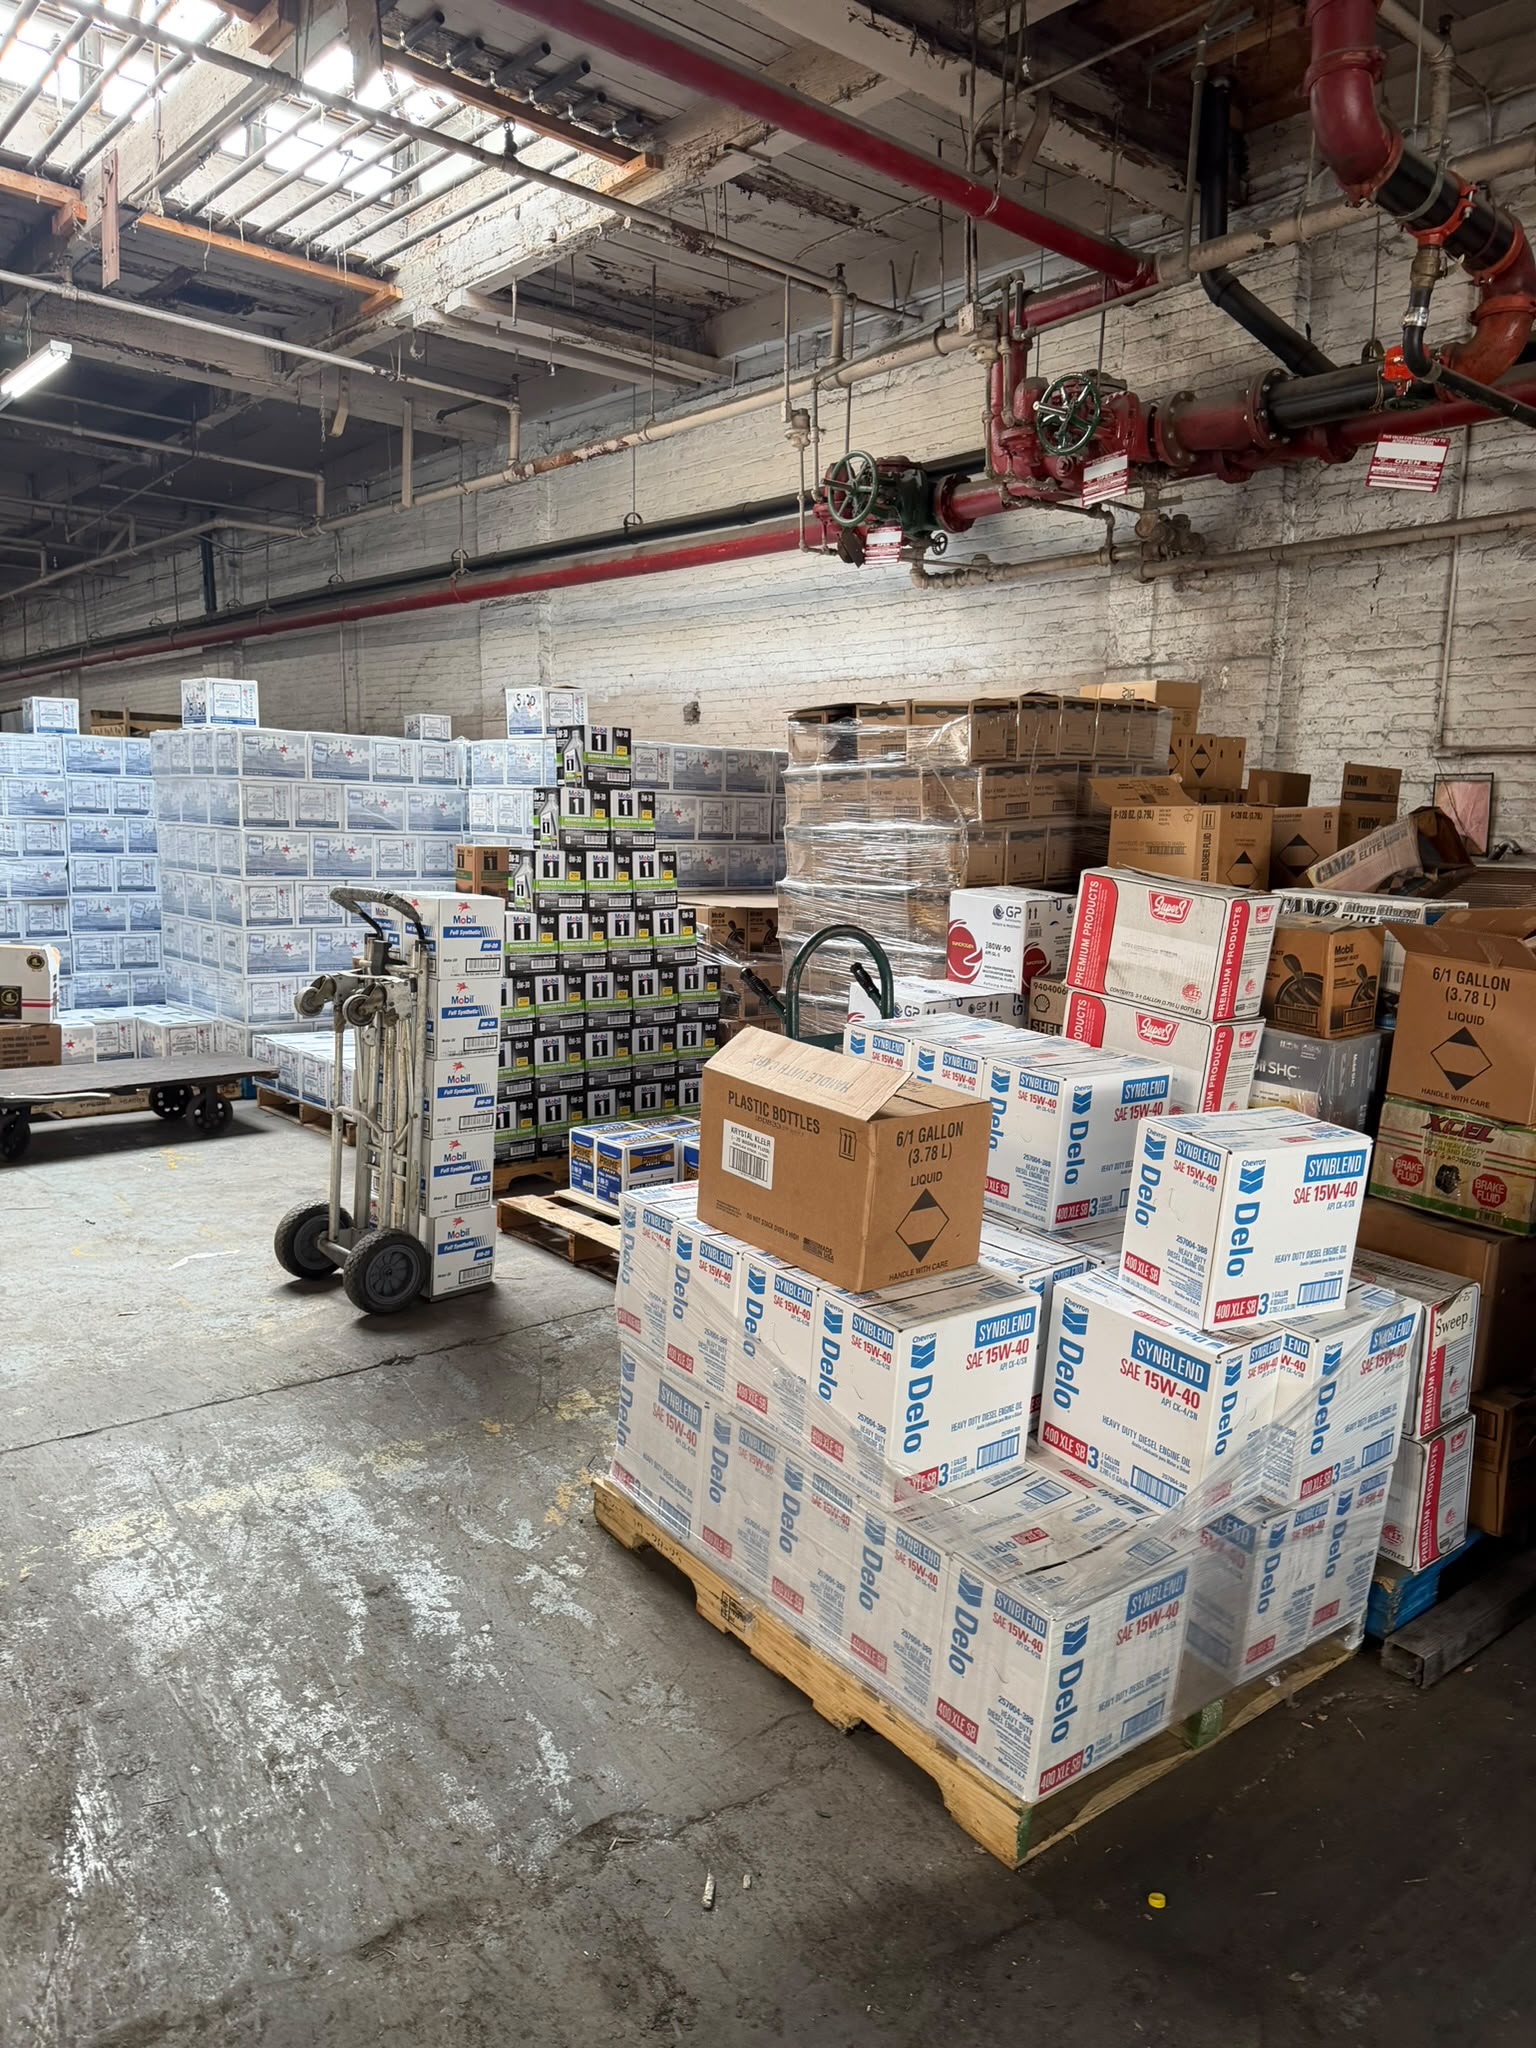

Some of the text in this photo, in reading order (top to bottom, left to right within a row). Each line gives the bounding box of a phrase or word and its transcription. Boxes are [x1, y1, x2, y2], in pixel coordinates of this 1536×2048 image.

[1359, 842, 1383, 861] ELITE
[453, 916, 476, 924] Mobil
[1006, 906, 1022, 918] GP
[1074, 880, 1100, 985] PREMIUM PRODUCTS
[1218, 906, 1242, 1017] PREMIUM PRODUCTS
[1335, 944, 1354, 955] Mobil
[1433, 967, 1510, 992] 6/1 GALLON
[451, 995, 474, 1004] Mobil
[1446, 986, 1496, 1010] (3.78 L)
[1074, 1000, 1087, 1040] ODUCTS
[1448, 1011, 1485, 1026] LIQUID
[1209, 1031, 1226, 1089] PRODUCTS
[1268, 1062, 1297, 1078] SHC
[447, 1074, 470, 1084] Mobil
[1020, 1075, 1059, 1094] SYNBLEND
[1125, 1080, 1166, 1099] SYNBLEND
[1029, 1093, 1056, 1108] 15W-40
[1421, 1087, 1490, 1109] HANDLE WITH CARE
[729, 1090, 769, 1117] PLASTIC
[772, 1104, 821, 1134] BOTTLES
[1130, 1102, 1163, 1120] 15W-40
[731, 1127, 753, 1141] KRYSTAL
[896, 1122, 963, 1148] 6/1 GALLON
[444, 1152, 466, 1162] Mobil
[908, 1143, 952, 1168] (3.78 L)
[1065, 1120, 1089, 1184] Delo
[1176, 1141, 1220, 1168] SYNBLEND
[1186, 1167, 1217, 1186] 15W-40
[1309, 1155, 1361, 1177] SYNBLEND
[1396, 1160, 1422, 1173] BRAKE
[1397, 1169, 1419, 1183] FLUID
[910, 1171, 942, 1187] LIQUID
[1475, 1180, 1504, 1194] BRAKE
[1135, 1164, 1161, 1226] Delo
[1293, 1181, 1358, 1204] SAE 15W-40
[1477, 1190, 1501, 1203] FLUID
[447, 1229, 470, 1239] Mobil
[1226, 1202, 1260, 1277] Delo
[889, 1259, 949, 1281] HANDLE WITH CARE
[775, 1277, 812, 1305] SYNBLEND
[774, 1295, 811, 1321] SAE 15W-40
[1064, 1297, 1089, 1313] Chevron
[1215, 1293, 1269, 1318] 400 XLE SB 3
[744, 1298, 763, 1359] Delo
[854, 1316, 893, 1346] SYNBLEND
[912, 1333, 937, 1343] Chevron
[979, 1313, 1032, 1342] SYNBLEND
[1435, 1313, 1469, 1338] Sweep
[851, 1335, 892, 1364] SAE 15W-40
[965, 1338, 1029, 1370] SAE 15W-40
[1136, 1338, 1205, 1384] SYNBLEND
[818, 1336, 840, 1402] Delo
[1053, 1337, 1085, 1411] Delo
[1120, 1358, 1200, 1410] SAE 15W-40
[903, 1374, 934, 1454] Delo
[1161, 1398, 1172, 1411] API
[1423, 1375, 1437, 1432] PREMIUM
[951, 1419, 967, 1432] HEAVY
[968, 1416, 981, 1428] DUTY
[982, 1410, 997, 1423] DIESEL
[998, 1404, 1015, 1419] ENGINE
[1044, 1428, 1099, 1469] 400 XLE SB 3
[1102, 1415, 1191, 1468] HEAVY DUTY DIESEL ENGINE OIL
[1422, 1445, 1439, 1562] PREMIUM PRODUCTS
[995, 1593, 1046, 1633] SYNBLEND
[949, 1606, 979, 1677] Delo
[993, 1612, 1043, 1653] SAE 15W-40
[1051, 1659, 1084, 1744] Delo
